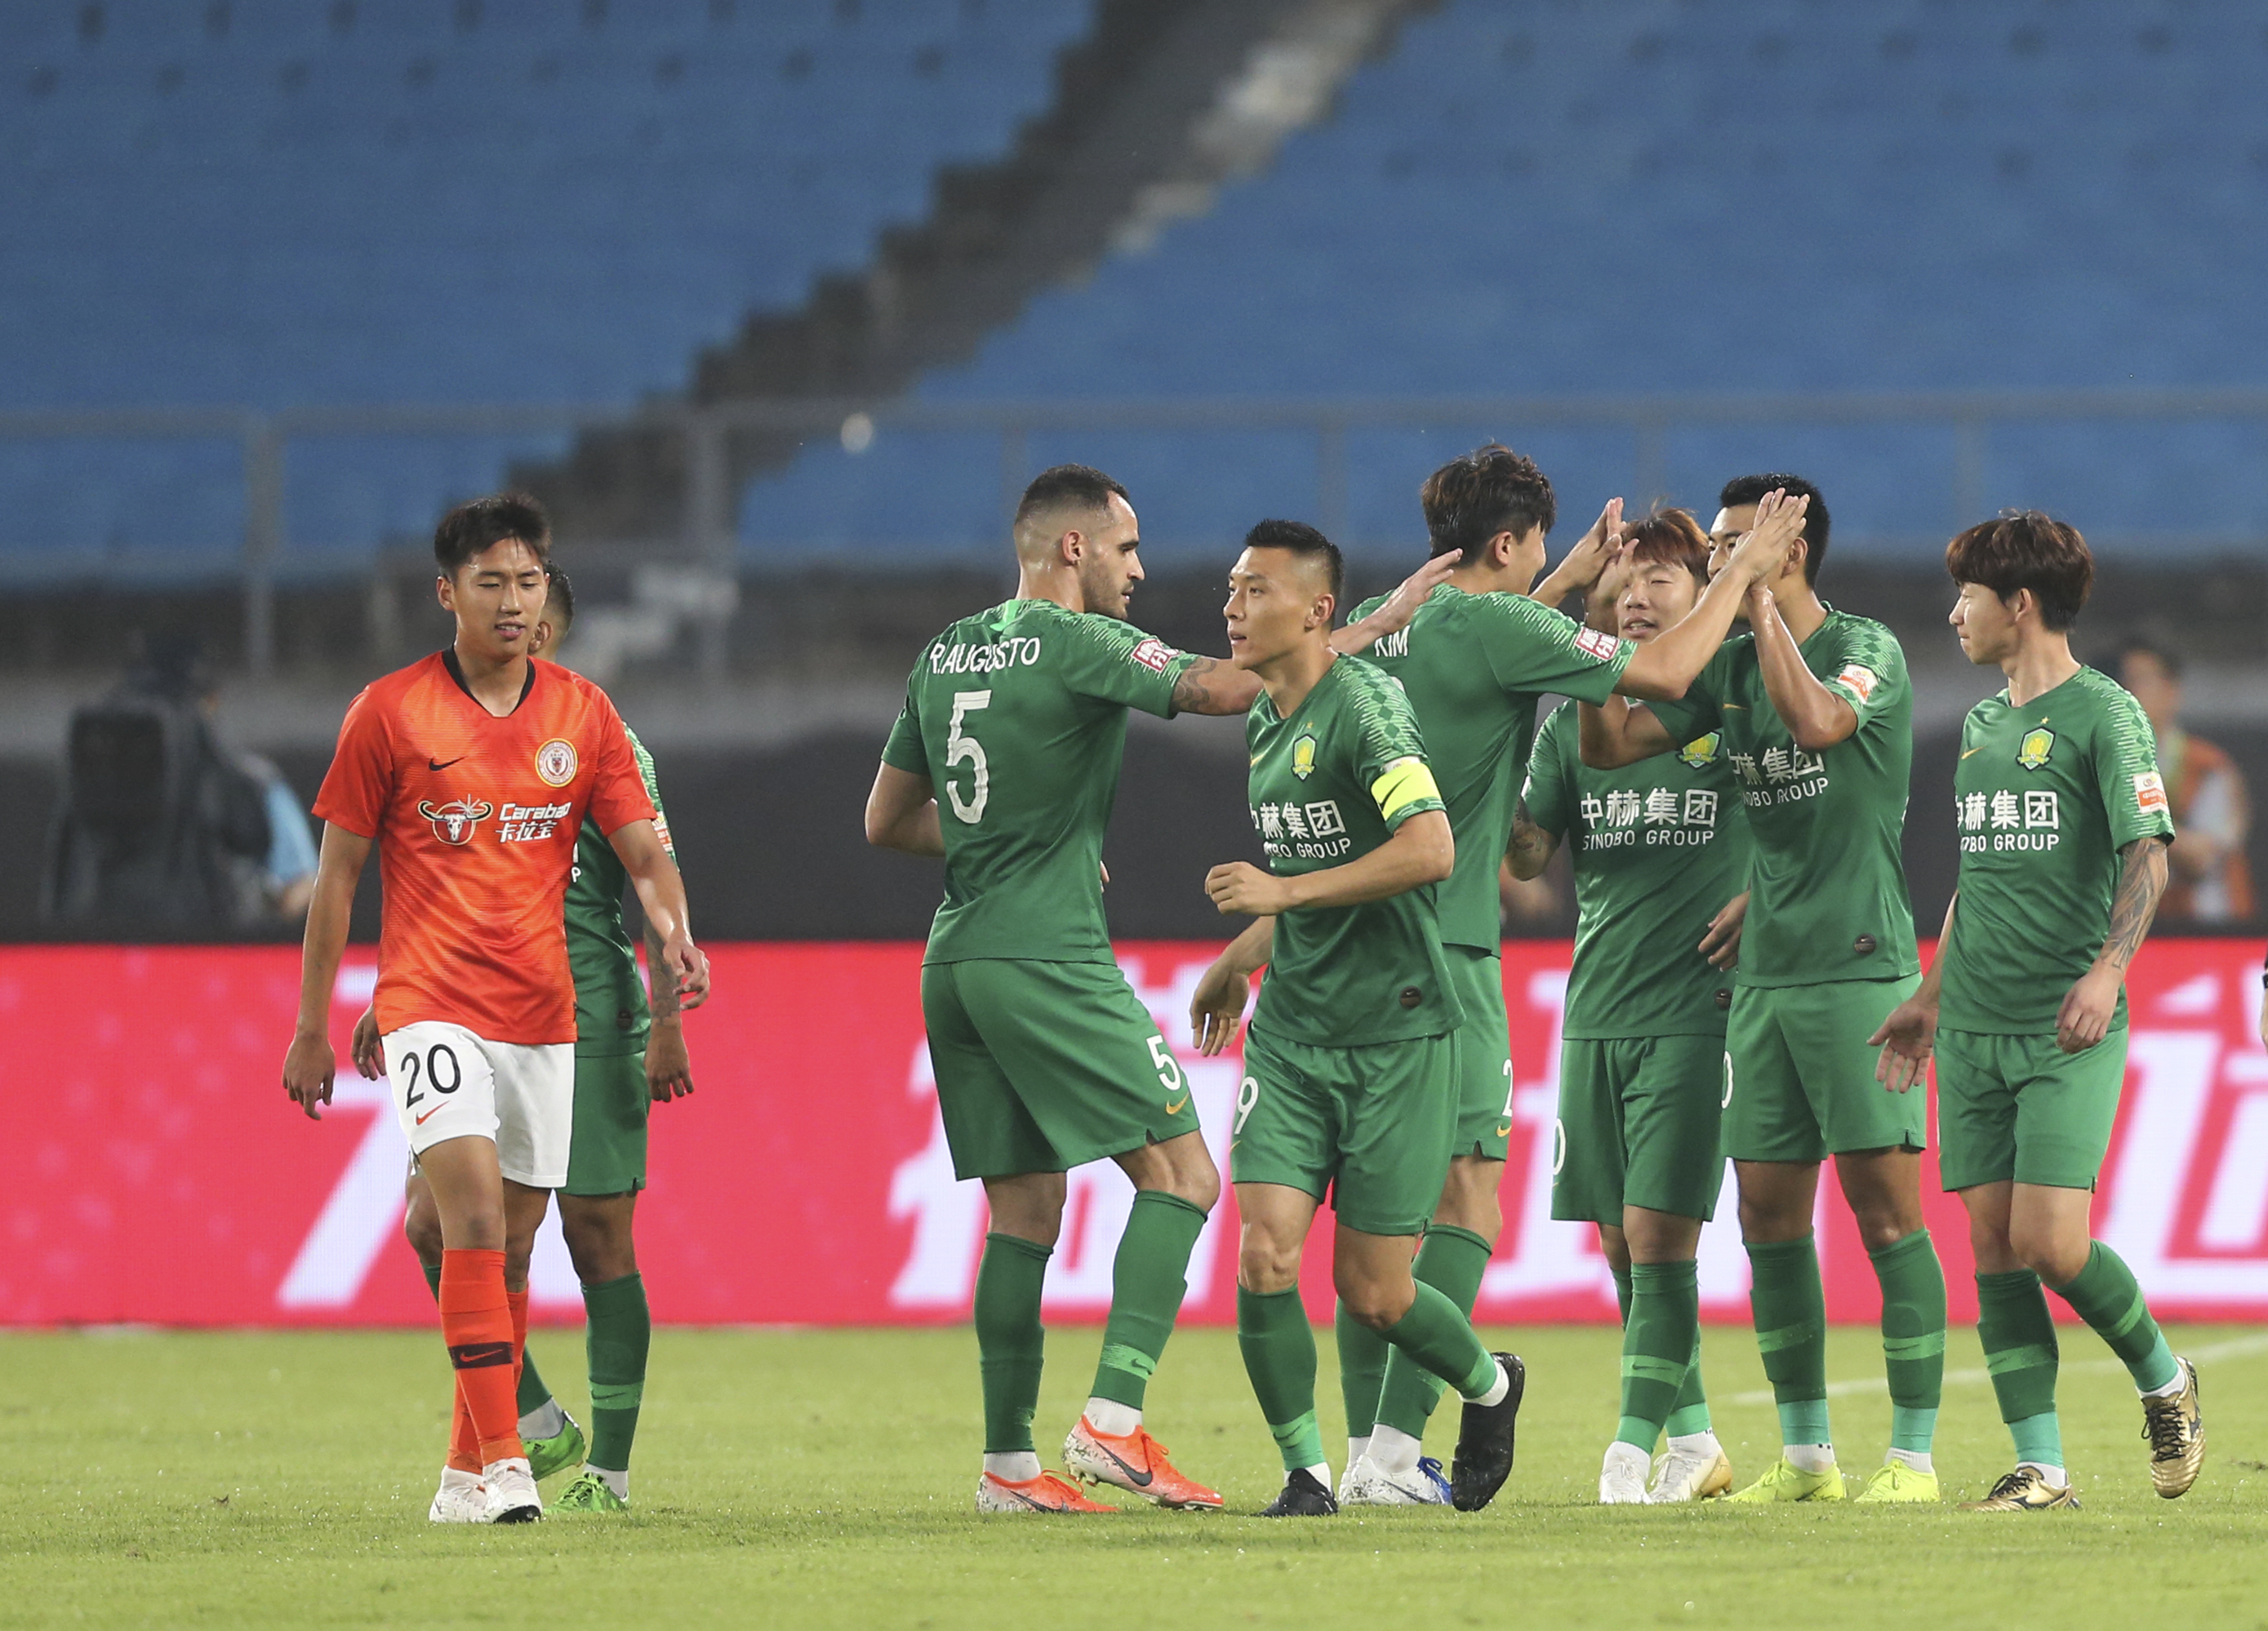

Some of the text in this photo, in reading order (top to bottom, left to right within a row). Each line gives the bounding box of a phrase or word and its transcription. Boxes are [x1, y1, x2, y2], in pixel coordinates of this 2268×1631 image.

[945, 690, 992, 824] 5
[499, 802, 571, 821] Carabao
[1580, 787, 1719, 830] 中赫集团
[495, 820, 558, 842] 卡拉宝
[1582, 829, 1714, 851] SINOBO GROUP
[1994, 833, 2060, 851] GROUP
[1296, 838, 1351, 859] GROUP
[1145, 1034, 1181, 1091] 5
[400, 1043, 461, 1109] 20
